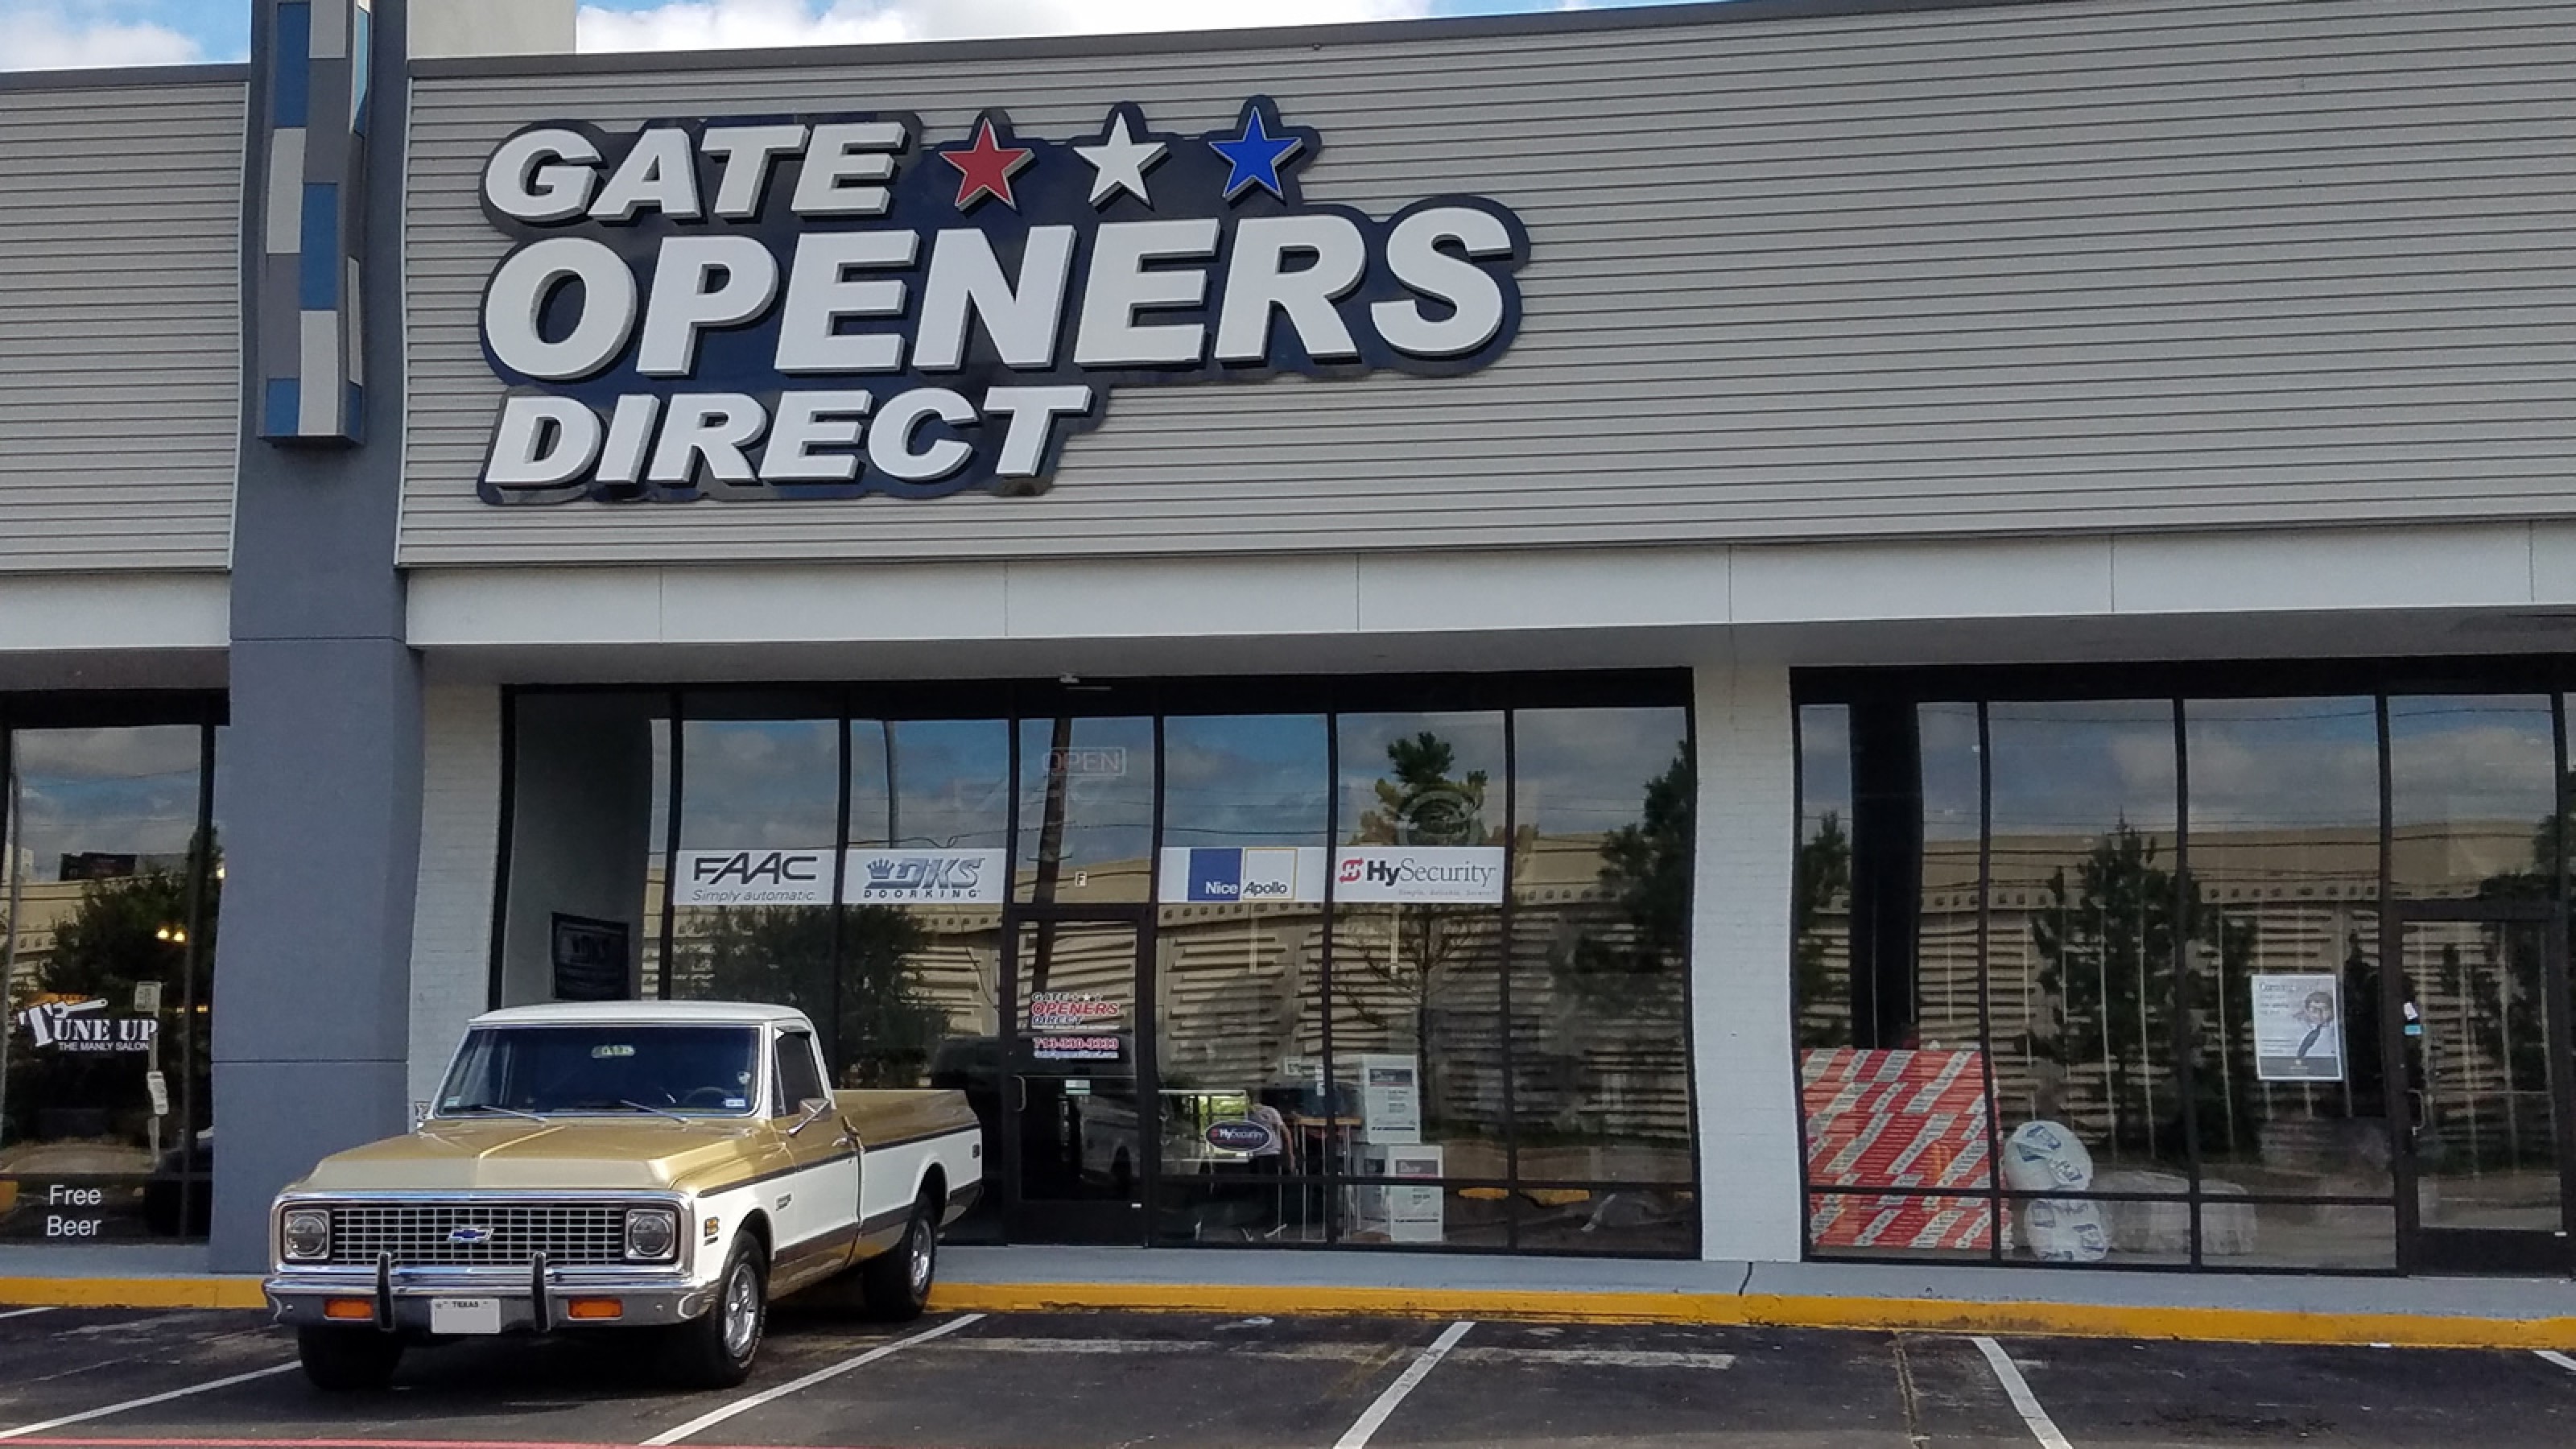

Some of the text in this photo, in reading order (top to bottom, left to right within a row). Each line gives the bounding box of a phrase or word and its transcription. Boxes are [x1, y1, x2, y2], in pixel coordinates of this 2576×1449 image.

[485, 121, 906, 223] GATE
[485, 205, 1513, 382] OPENERS
[485, 384, 1093, 488] DIRECT
[1043, 752, 1120, 772] OPEN
[693, 852, 817, 885] FAAC
[894, 857, 985, 888] DKS
[1367, 858, 1496, 887] HySecurity
[692, 890, 740, 903] Simply
[864, 889, 978, 899] DOORKING
[1205, 881, 1287, 896] Nice Apollo
[1032, 1001, 1119, 1016] OPENERS
[19, 1003, 158, 1046] TUNE UP
[59, 1042, 150, 1051] THE MANLY SALON
[49, 1186, 101, 1205] Free
[46, 1216, 101, 1236] Beer
[452, 1300, 479, 1308] TEXAS
